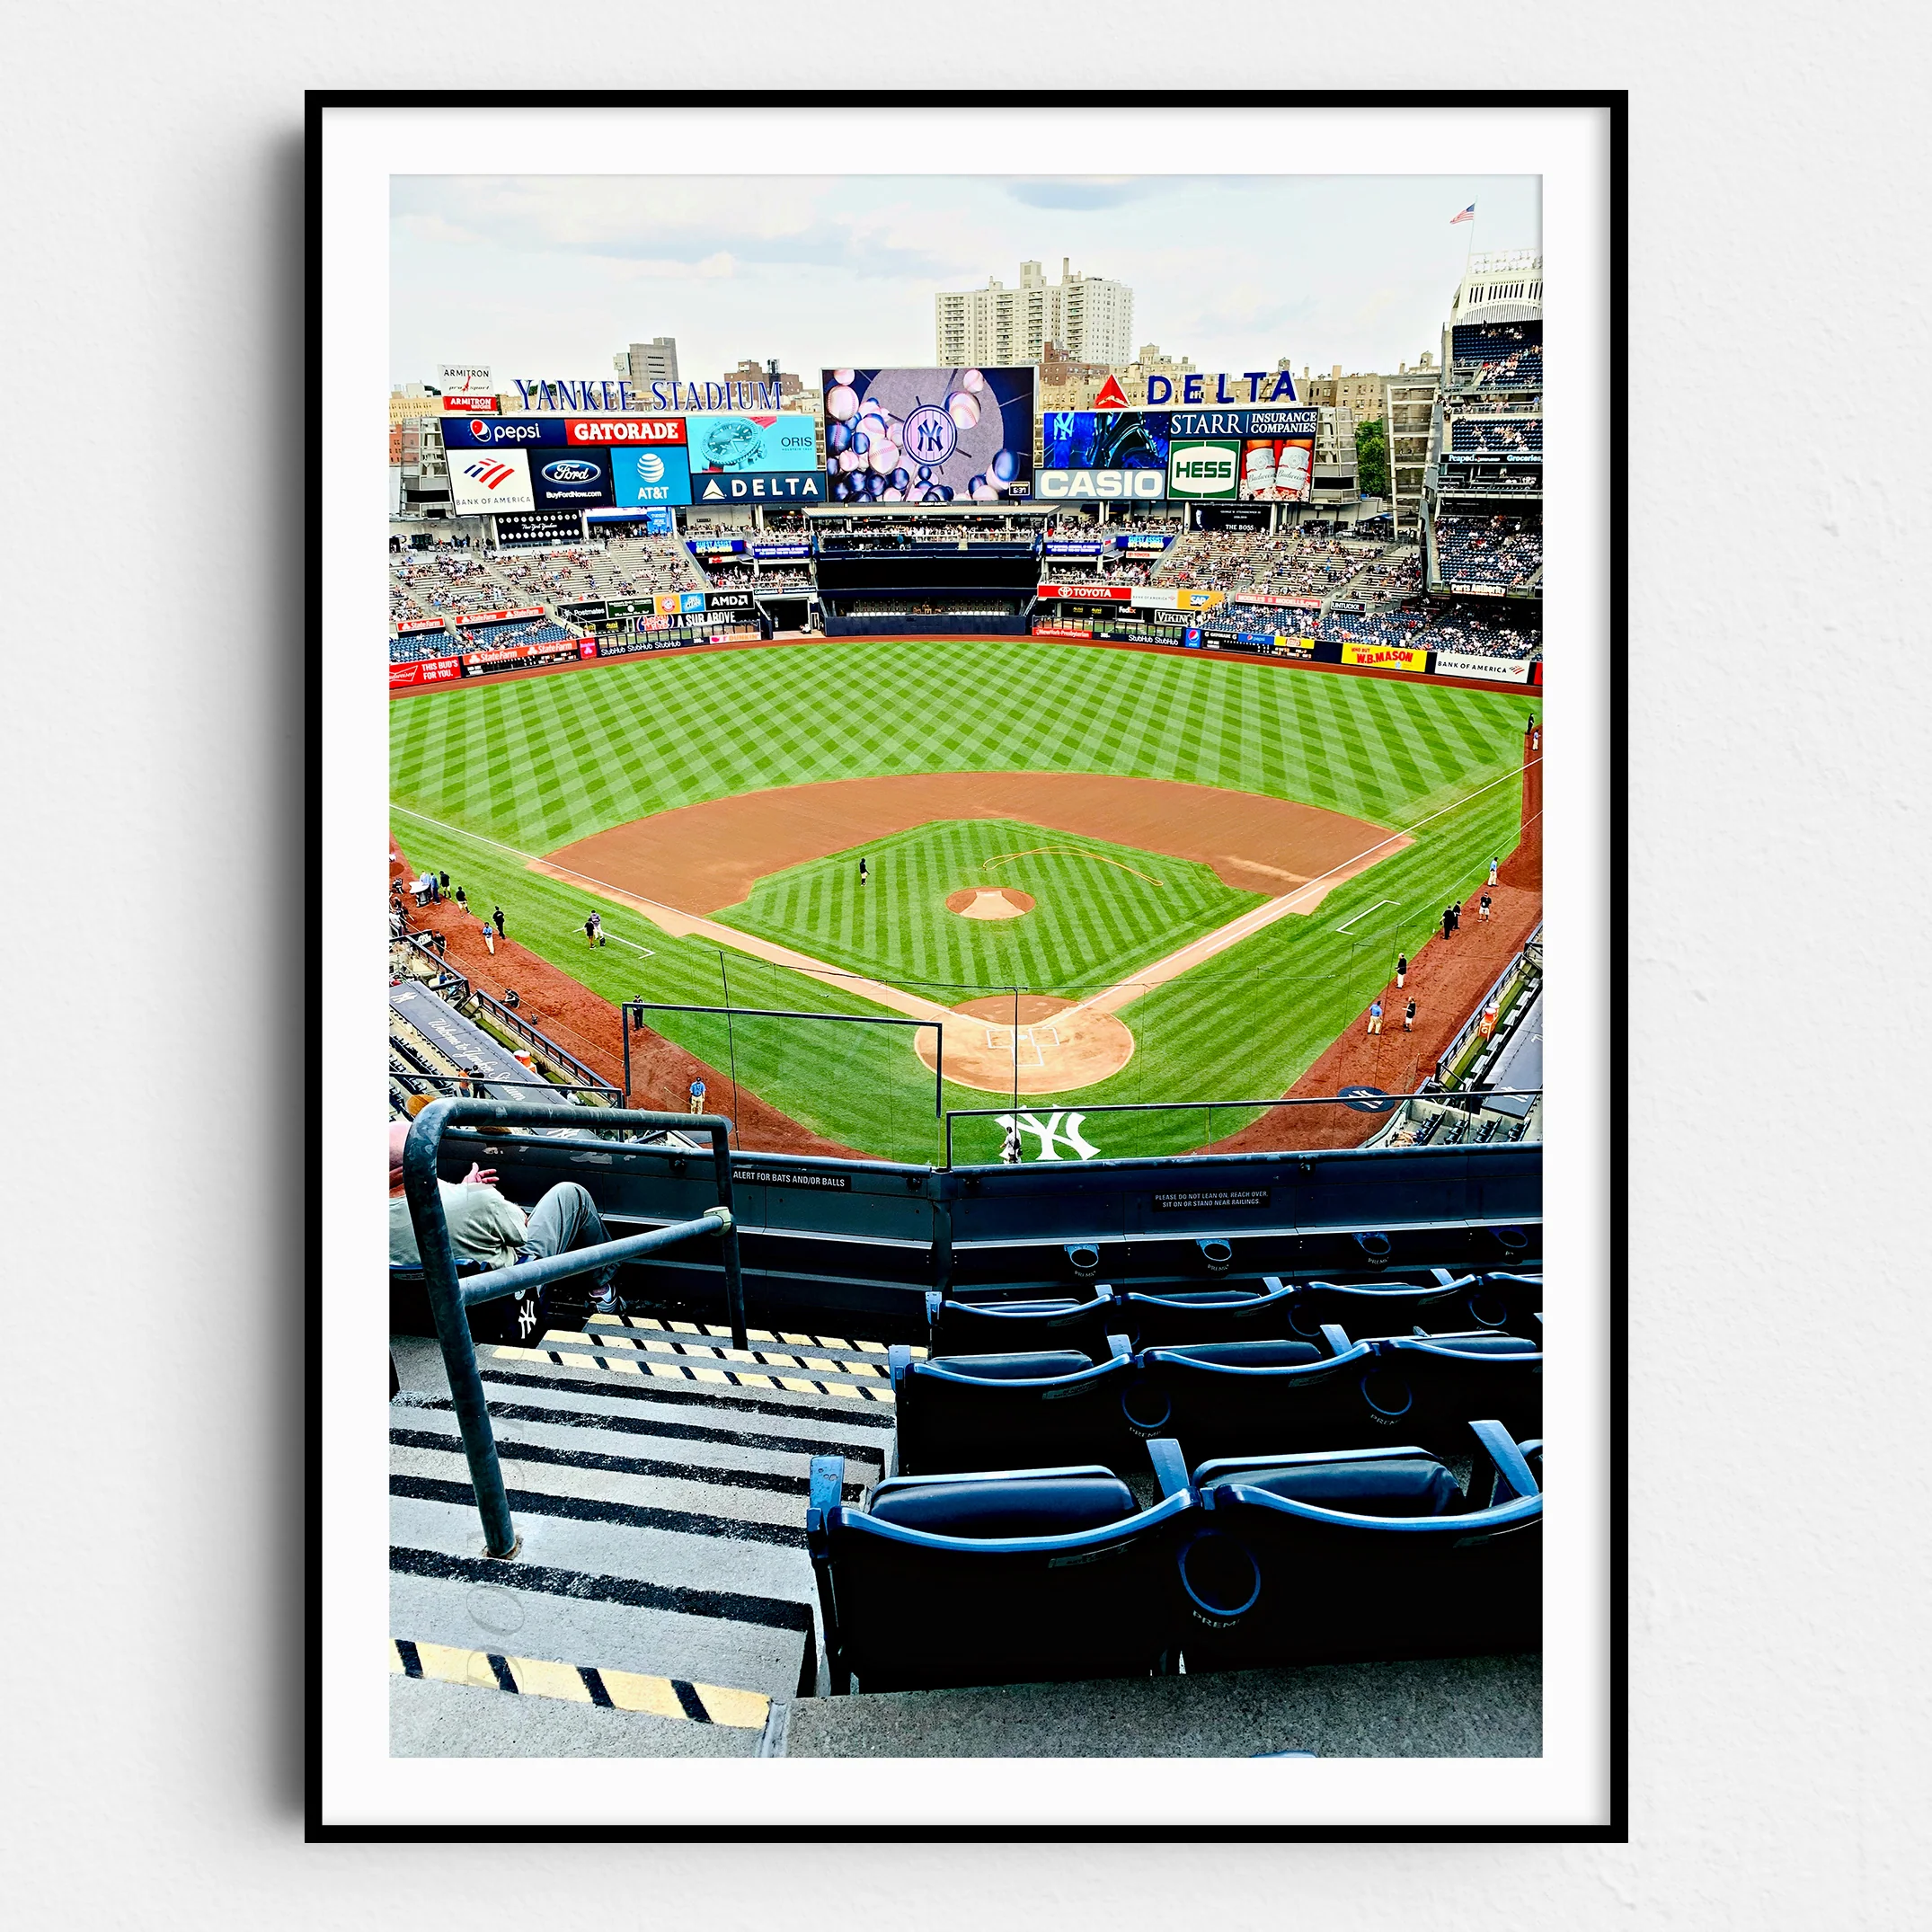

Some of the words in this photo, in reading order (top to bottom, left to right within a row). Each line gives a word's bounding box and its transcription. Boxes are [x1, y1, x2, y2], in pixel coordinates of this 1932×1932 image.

[444, 369, 490, 377] ARMITRON
[1148, 369, 1300, 404] DELTA
[450, 397, 492, 405] ARMITRON
[510, 378, 635, 412] YANKEE
[651, 380, 783, 411] STADIUM
[1170, 413, 1243, 434] STARR
[1251, 412, 1317, 423] INSURANCE
[493, 423, 540, 442] pepsi
[574, 422, 678, 440] GATORADE
[1250, 422, 1316, 434] COMPANIES
[781, 437, 812, 448] ORIS
[554, 463, 589, 480] Ford
[1175, 461, 1232, 478] HESS
[731, 478, 819, 497] DELTA
[1041, 470, 1163, 498] CASIO
[545, 491, 602, 499] BuyFordNow.com
[637, 486, 669, 500] AT&T
[456, 498, 480, 506] BANK
[493, 496, 531, 504] AMERICA
[1073, 588, 1112, 598] TOYOTA
[711, 596, 737, 607] AMD
[1190, 596, 1206, 606] SAP
[573, 607, 605, 616] Postmates
[1118, 606, 1137, 614] FedEx
[677, 616, 684, 628] A
[706, 611, 737, 625] ABOVE
[1157, 611, 1193, 625] VIKING
[1128, 634, 1154, 643] StubHub
[1154, 636, 1179, 646] StubHub
[600, 646, 626, 657] StubHub
[627, 643, 653, 652] StubHub
[654, 641, 681, 650] StubHub
[421, 662, 438, 672] THIS
[438, 660, 458, 669] BUD'S
[1438, 660, 1458, 669] BANK
[1471, 664, 1507, 674] AMERICA
[422, 671, 437, 680] FOR
[437, 669, 454, 678] YOU.
[733, 1171, 756, 1180] ALERT
[757, 1173, 771, 1181] FOR
[772, 1174, 791, 1183] BATS
[792, 1175, 821, 1185] AND/OR
[821, 1177, 846, 1187] BALLS
